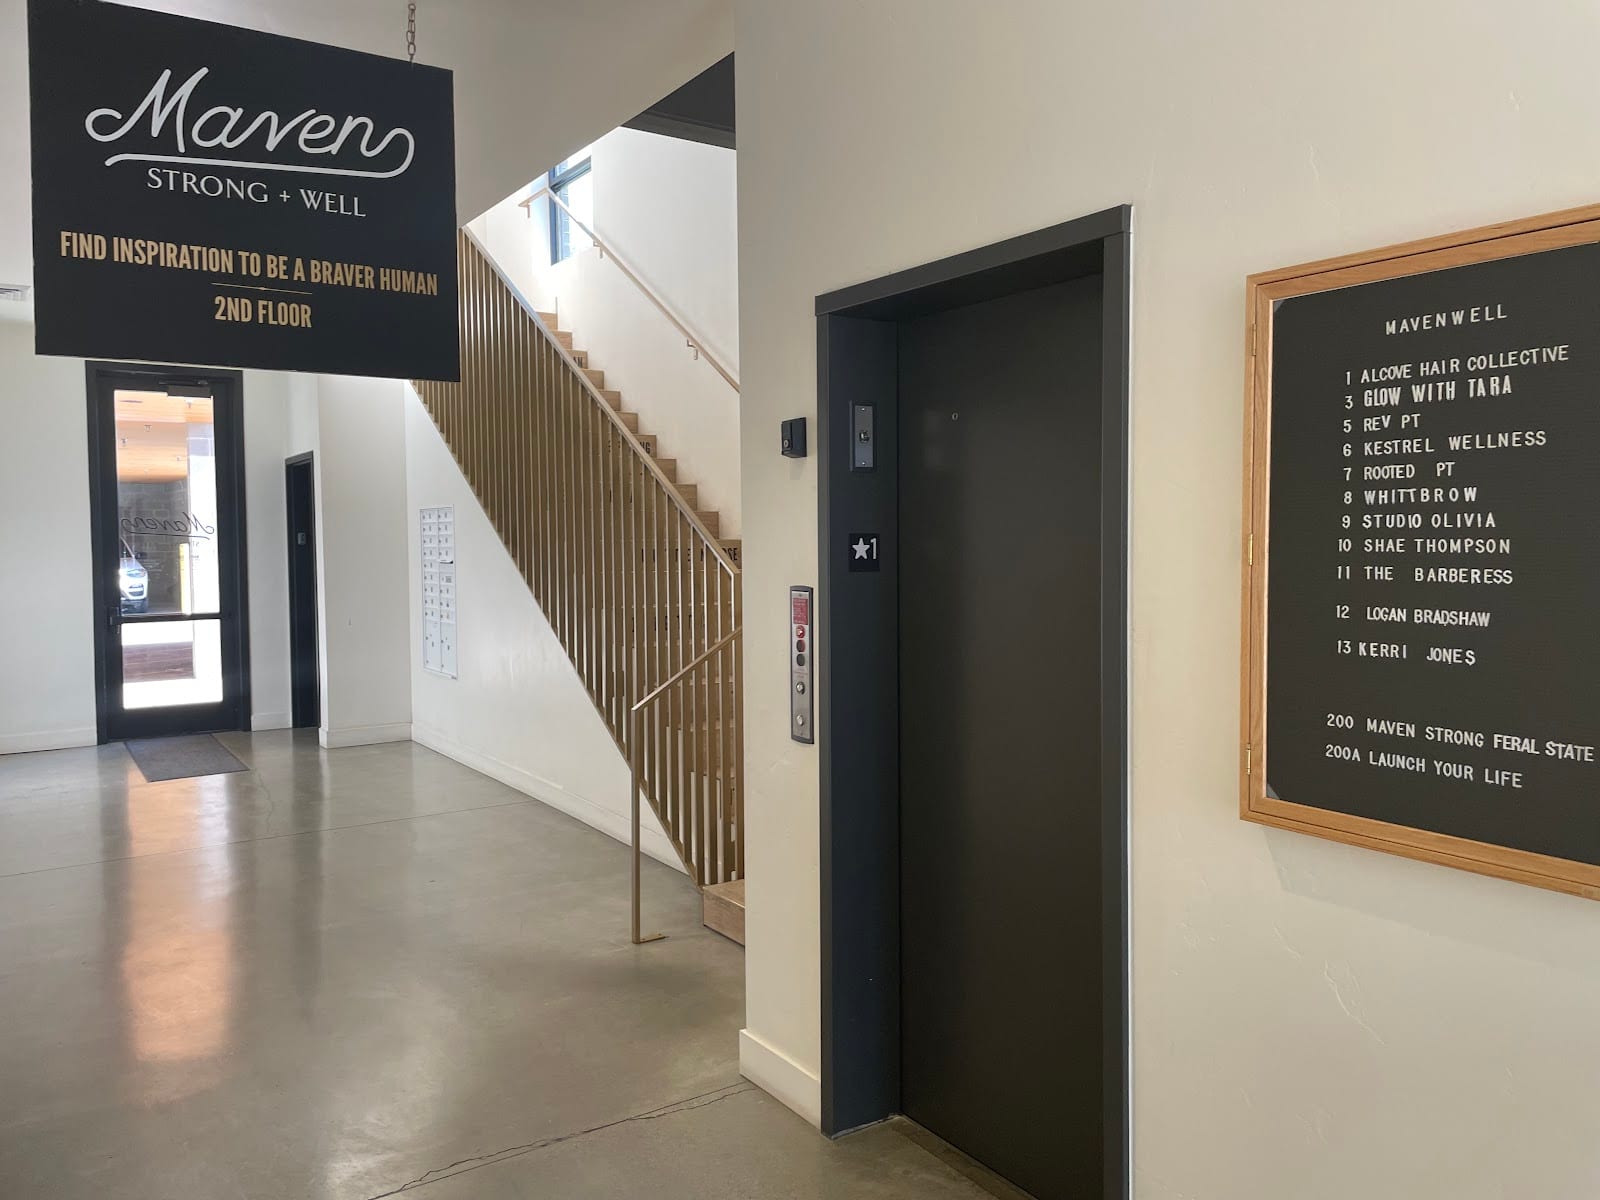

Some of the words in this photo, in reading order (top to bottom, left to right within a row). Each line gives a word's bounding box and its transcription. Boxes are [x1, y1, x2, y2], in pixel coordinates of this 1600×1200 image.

[85, 67, 414, 178] Maven
[147, 168, 268, 203] STRONG
[280, 190, 291, 203] +
[299, 189, 366, 217] WELL
[61, 231, 107, 260] FIND
[113, 237, 233, 273] INSPIRATION
[238, 251, 260, 277] TO
[267, 255, 288, 281] BE
[294, 258, 305, 281] A
[310, 260, 374, 288] BRAVER
[380, 268, 437, 295] HUMAN
[215, 296, 252, 322] 2ND
[258, 300, 312, 327] FLOOR
[1346, 371, 1351, 385] 1
[1361, 364, 1412, 383] ALCOVE
[1420, 359, 1460, 376] HAIR
[1467, 345, 1569, 371] COLLECTIVE
[1344, 396, 1353, 409] 3
[1364, 387, 1401, 407] GLOW
[1412, 381, 1455, 402] WITH
[1468, 375, 1512, 398] TARA
[1343, 420, 1352, 433] 5
[1364, 415, 1391, 432] REV
[1401, 414, 1421, 428] PT
[1343, 444, 1352, 457] 6
[1364, 438, 1434, 456] KESTREL
[1449, 431, 1547, 451] WELLNESS
[1343, 468, 1352, 481] 7
[1364, 464, 1415, 480] ROOTED
[1436, 462, 1455, 476] PT
[1343, 491, 1352, 504] 8
[1364, 487, 1477, 505] WHITTBROW
[1342, 515, 1351, 528] 9
[1362, 514, 1422, 529] STUDIO
[1431, 512, 1496, 528] OLIVIA
[870, 537, 877, 560] 1
[1338, 539, 1352, 552] 10
[1364, 539, 1405, 553] SHAE
[1414, 538, 1510, 553] THOMPSON
[1337, 565, 1350, 580] 11
[1363, 566, 1393, 580] THE
[1415, 567, 1513, 584] BARBERESS
[1336, 605, 1349, 619] 12
[1366, 606, 1407, 622] LOGAN
[1414, 609, 1490, 627] BRADSHAW
[1337, 640, 1352, 654] 13
[1359, 642, 1407, 659] KERRI
[1426, 647, 1476, 665] JONES
[1327, 714, 1354, 729] 200
[1367, 718, 1415, 738] MAVEN
[1425, 727, 1484, 747] STRONG
[1494, 734, 1539, 754] FERAL
[1545, 741, 1594, 761] STATE
[1325, 745, 1361, 762] 200A
[1369, 751, 1425, 773] LAUNCH
[1433, 760, 1473, 781] YOUR
[1485, 769, 1522, 788] LIFE
